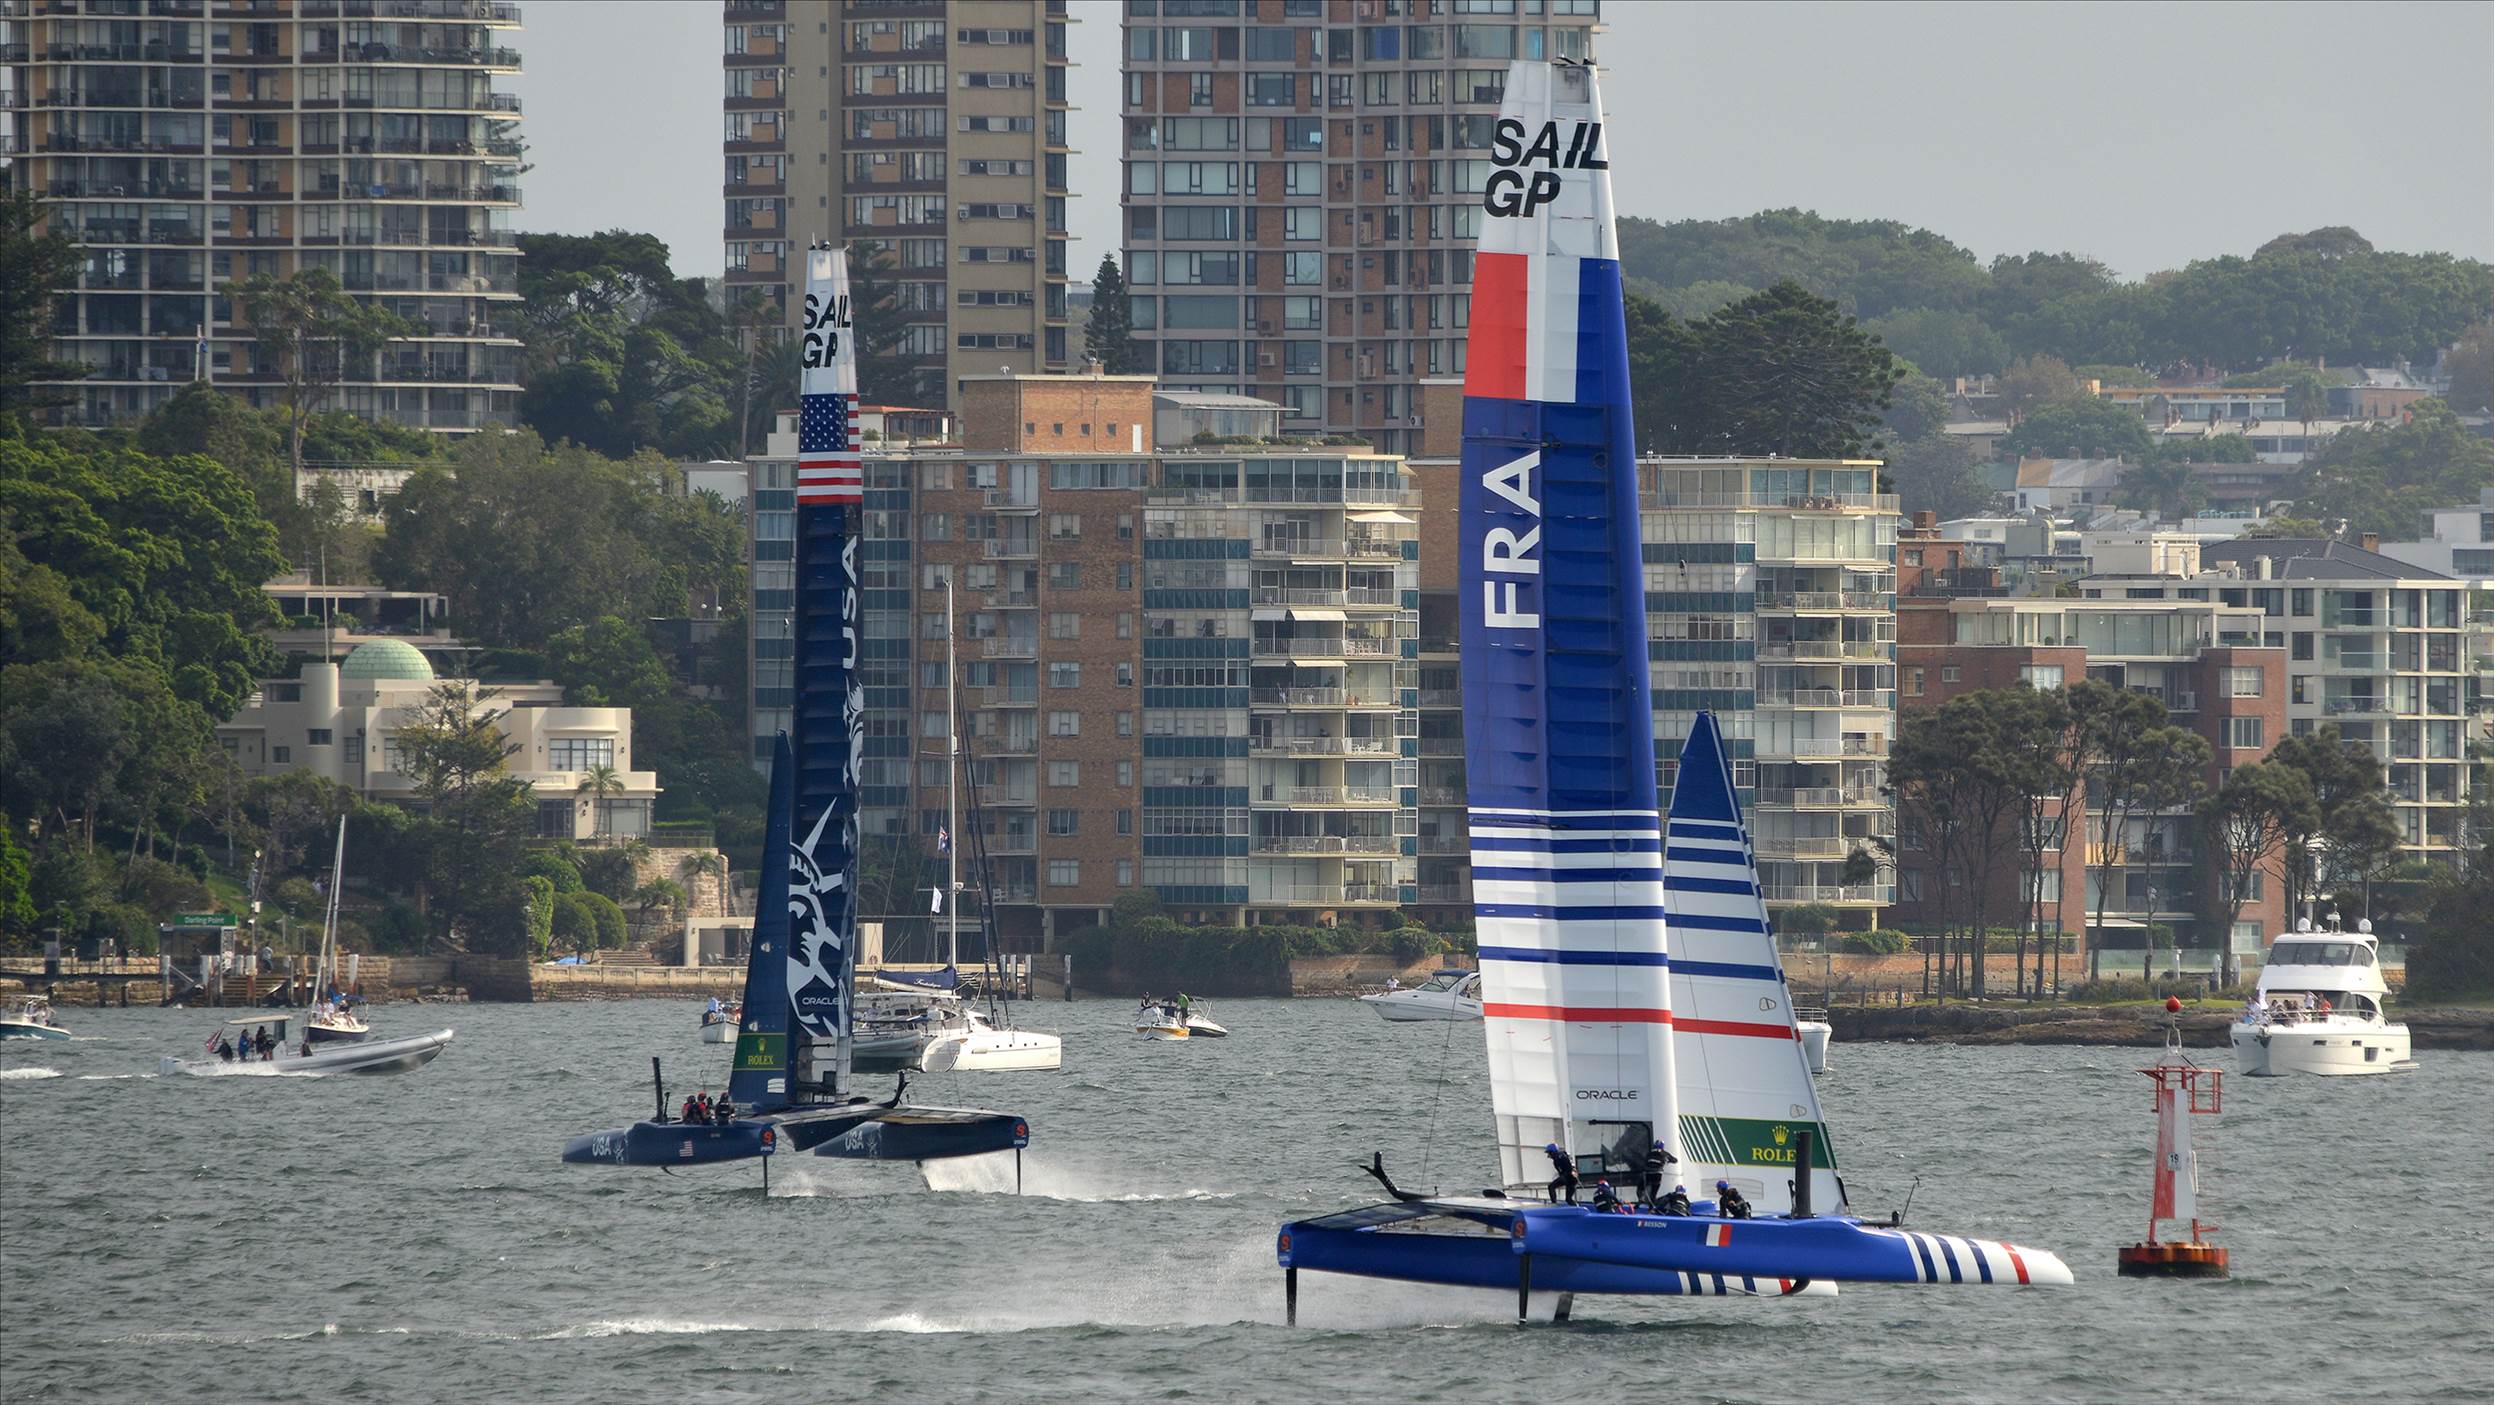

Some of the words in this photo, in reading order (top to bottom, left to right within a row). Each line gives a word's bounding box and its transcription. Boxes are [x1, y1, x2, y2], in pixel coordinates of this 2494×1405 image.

[1491, 119, 1608, 170] SAIL
[1484, 170, 1562, 218] GP
[803, 293, 851, 330] SAIL
[802, 332, 838, 369] GP
[1482, 450, 1541, 629] FRA
[841, 535, 858, 669] USA
[802, 997, 841, 1006] ORACLE
[748, 1055, 774, 1065] ROLEX
[1576, 1090, 1638, 1100] ORACLE
[592, 1135, 611, 1157] USA
[845, 1130, 864, 1150] USA
[1752, 1147, 1797, 1162] ROLE
